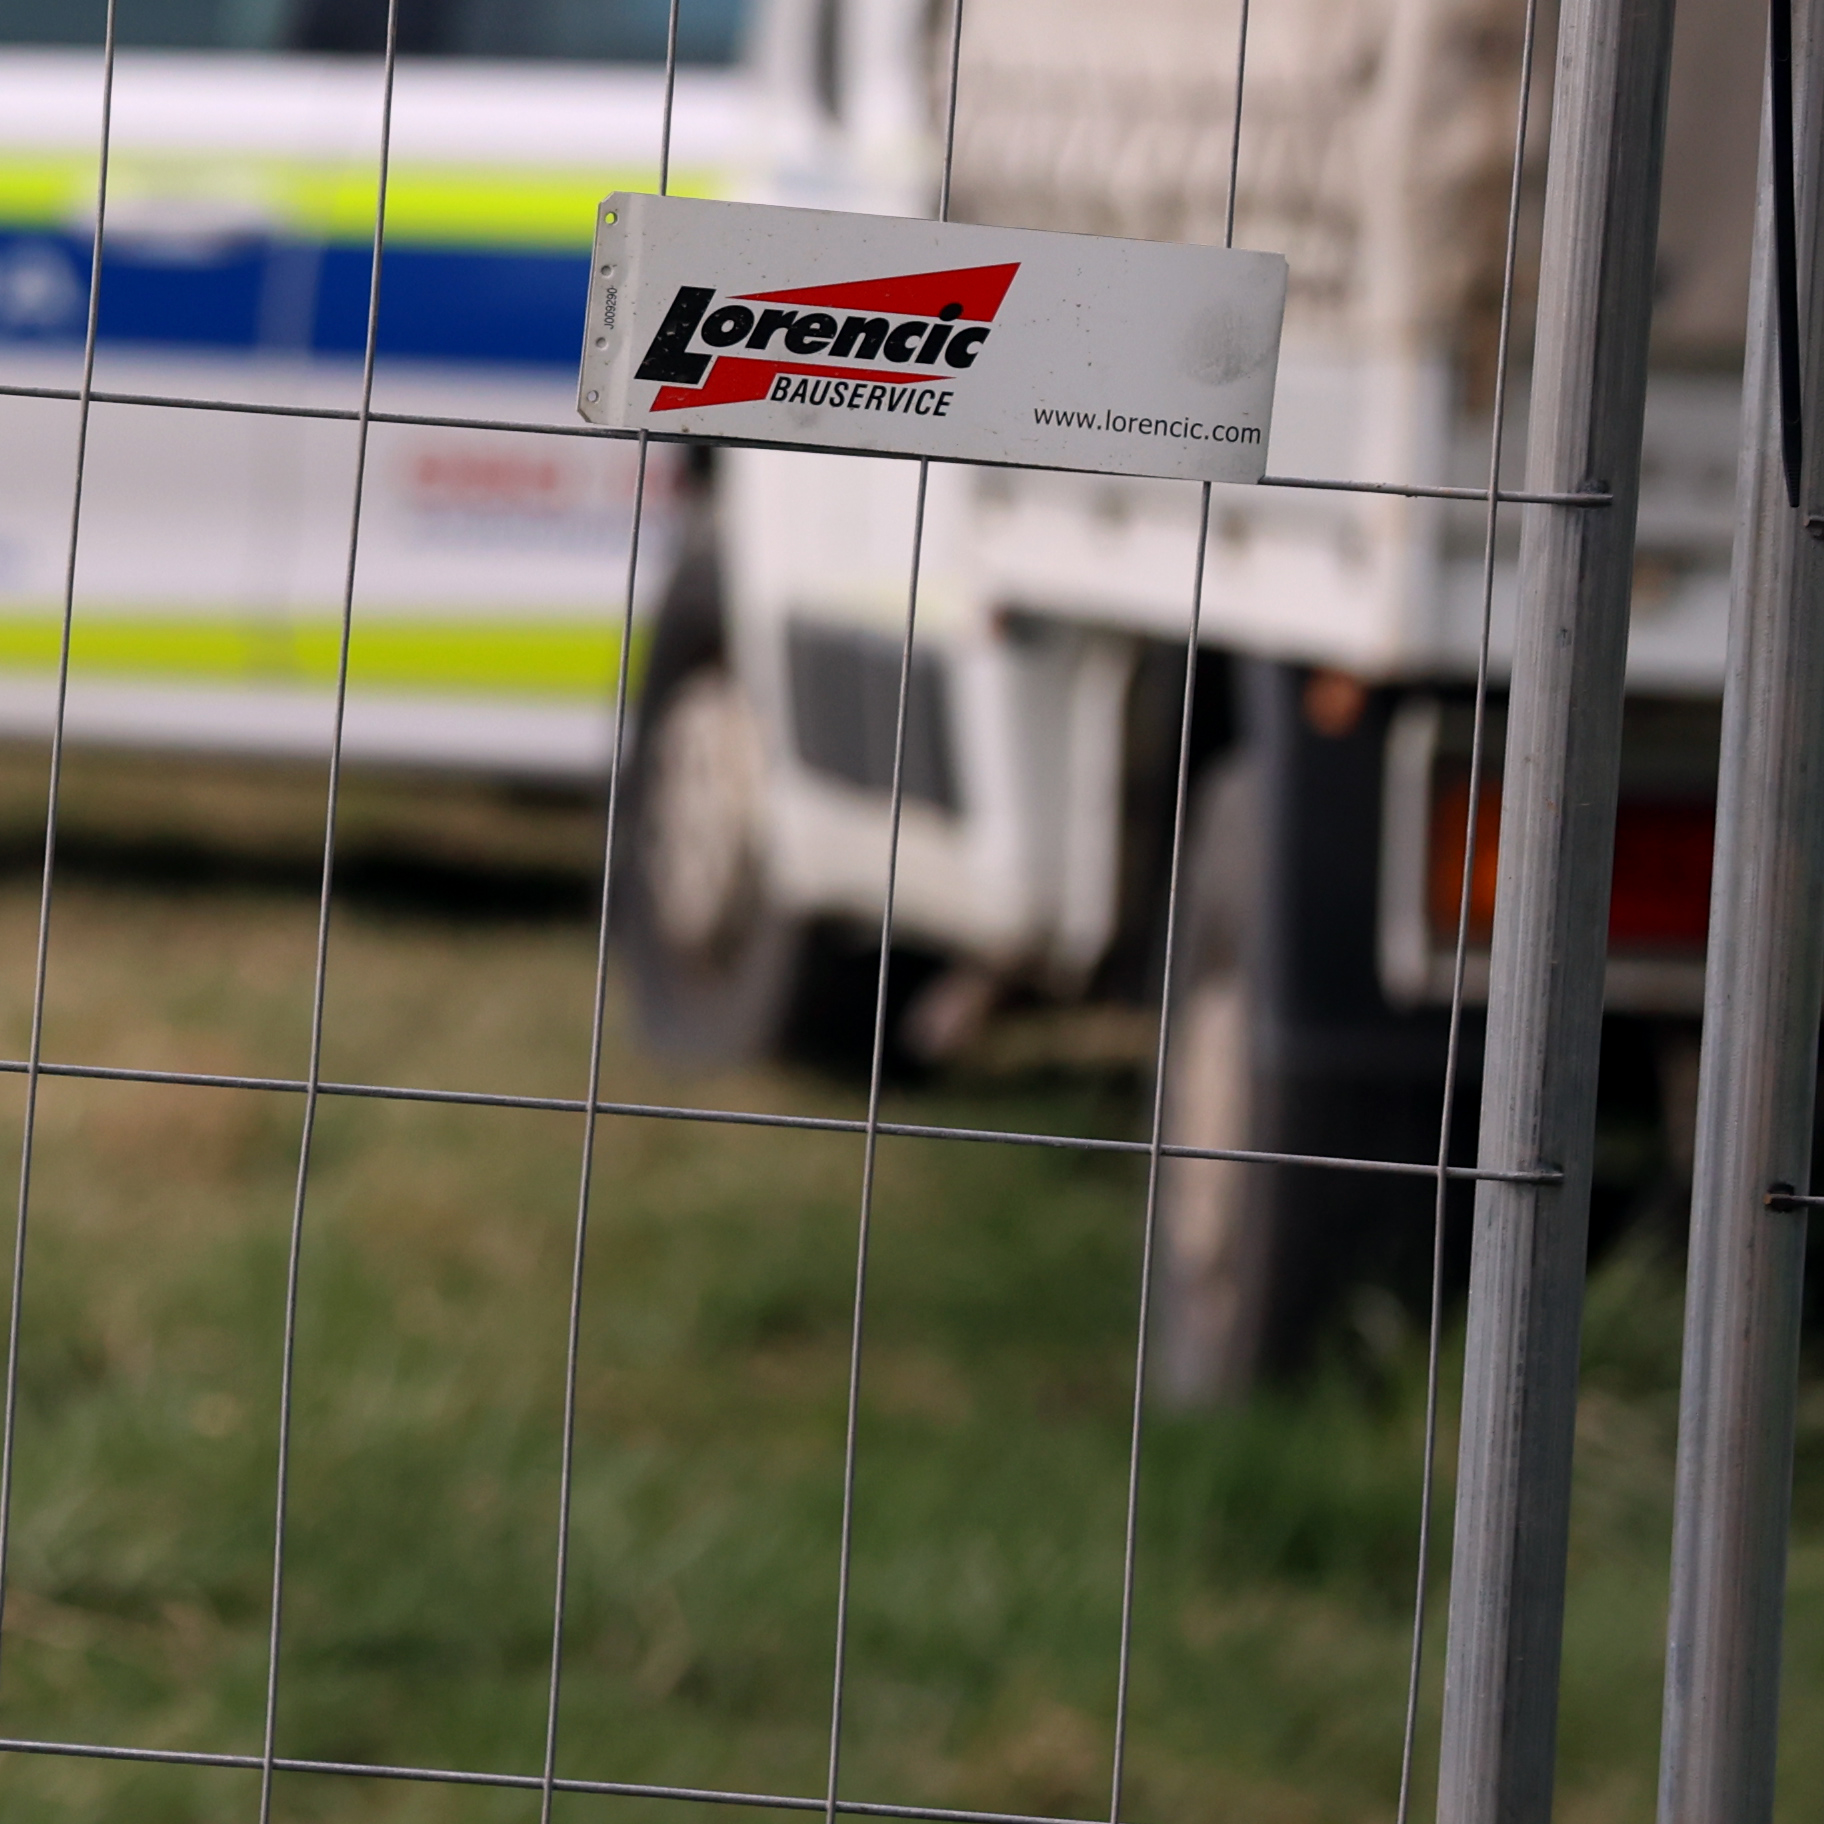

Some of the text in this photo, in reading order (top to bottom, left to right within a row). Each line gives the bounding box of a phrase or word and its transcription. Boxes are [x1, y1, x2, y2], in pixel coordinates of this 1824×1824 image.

[604, 287, 618, 330] J009290
[634, 285, 992, 385] Lorencic
[770, 376, 954, 417] BAUSERVICE
[1034, 407, 1262, 445] www.lorencic.com
